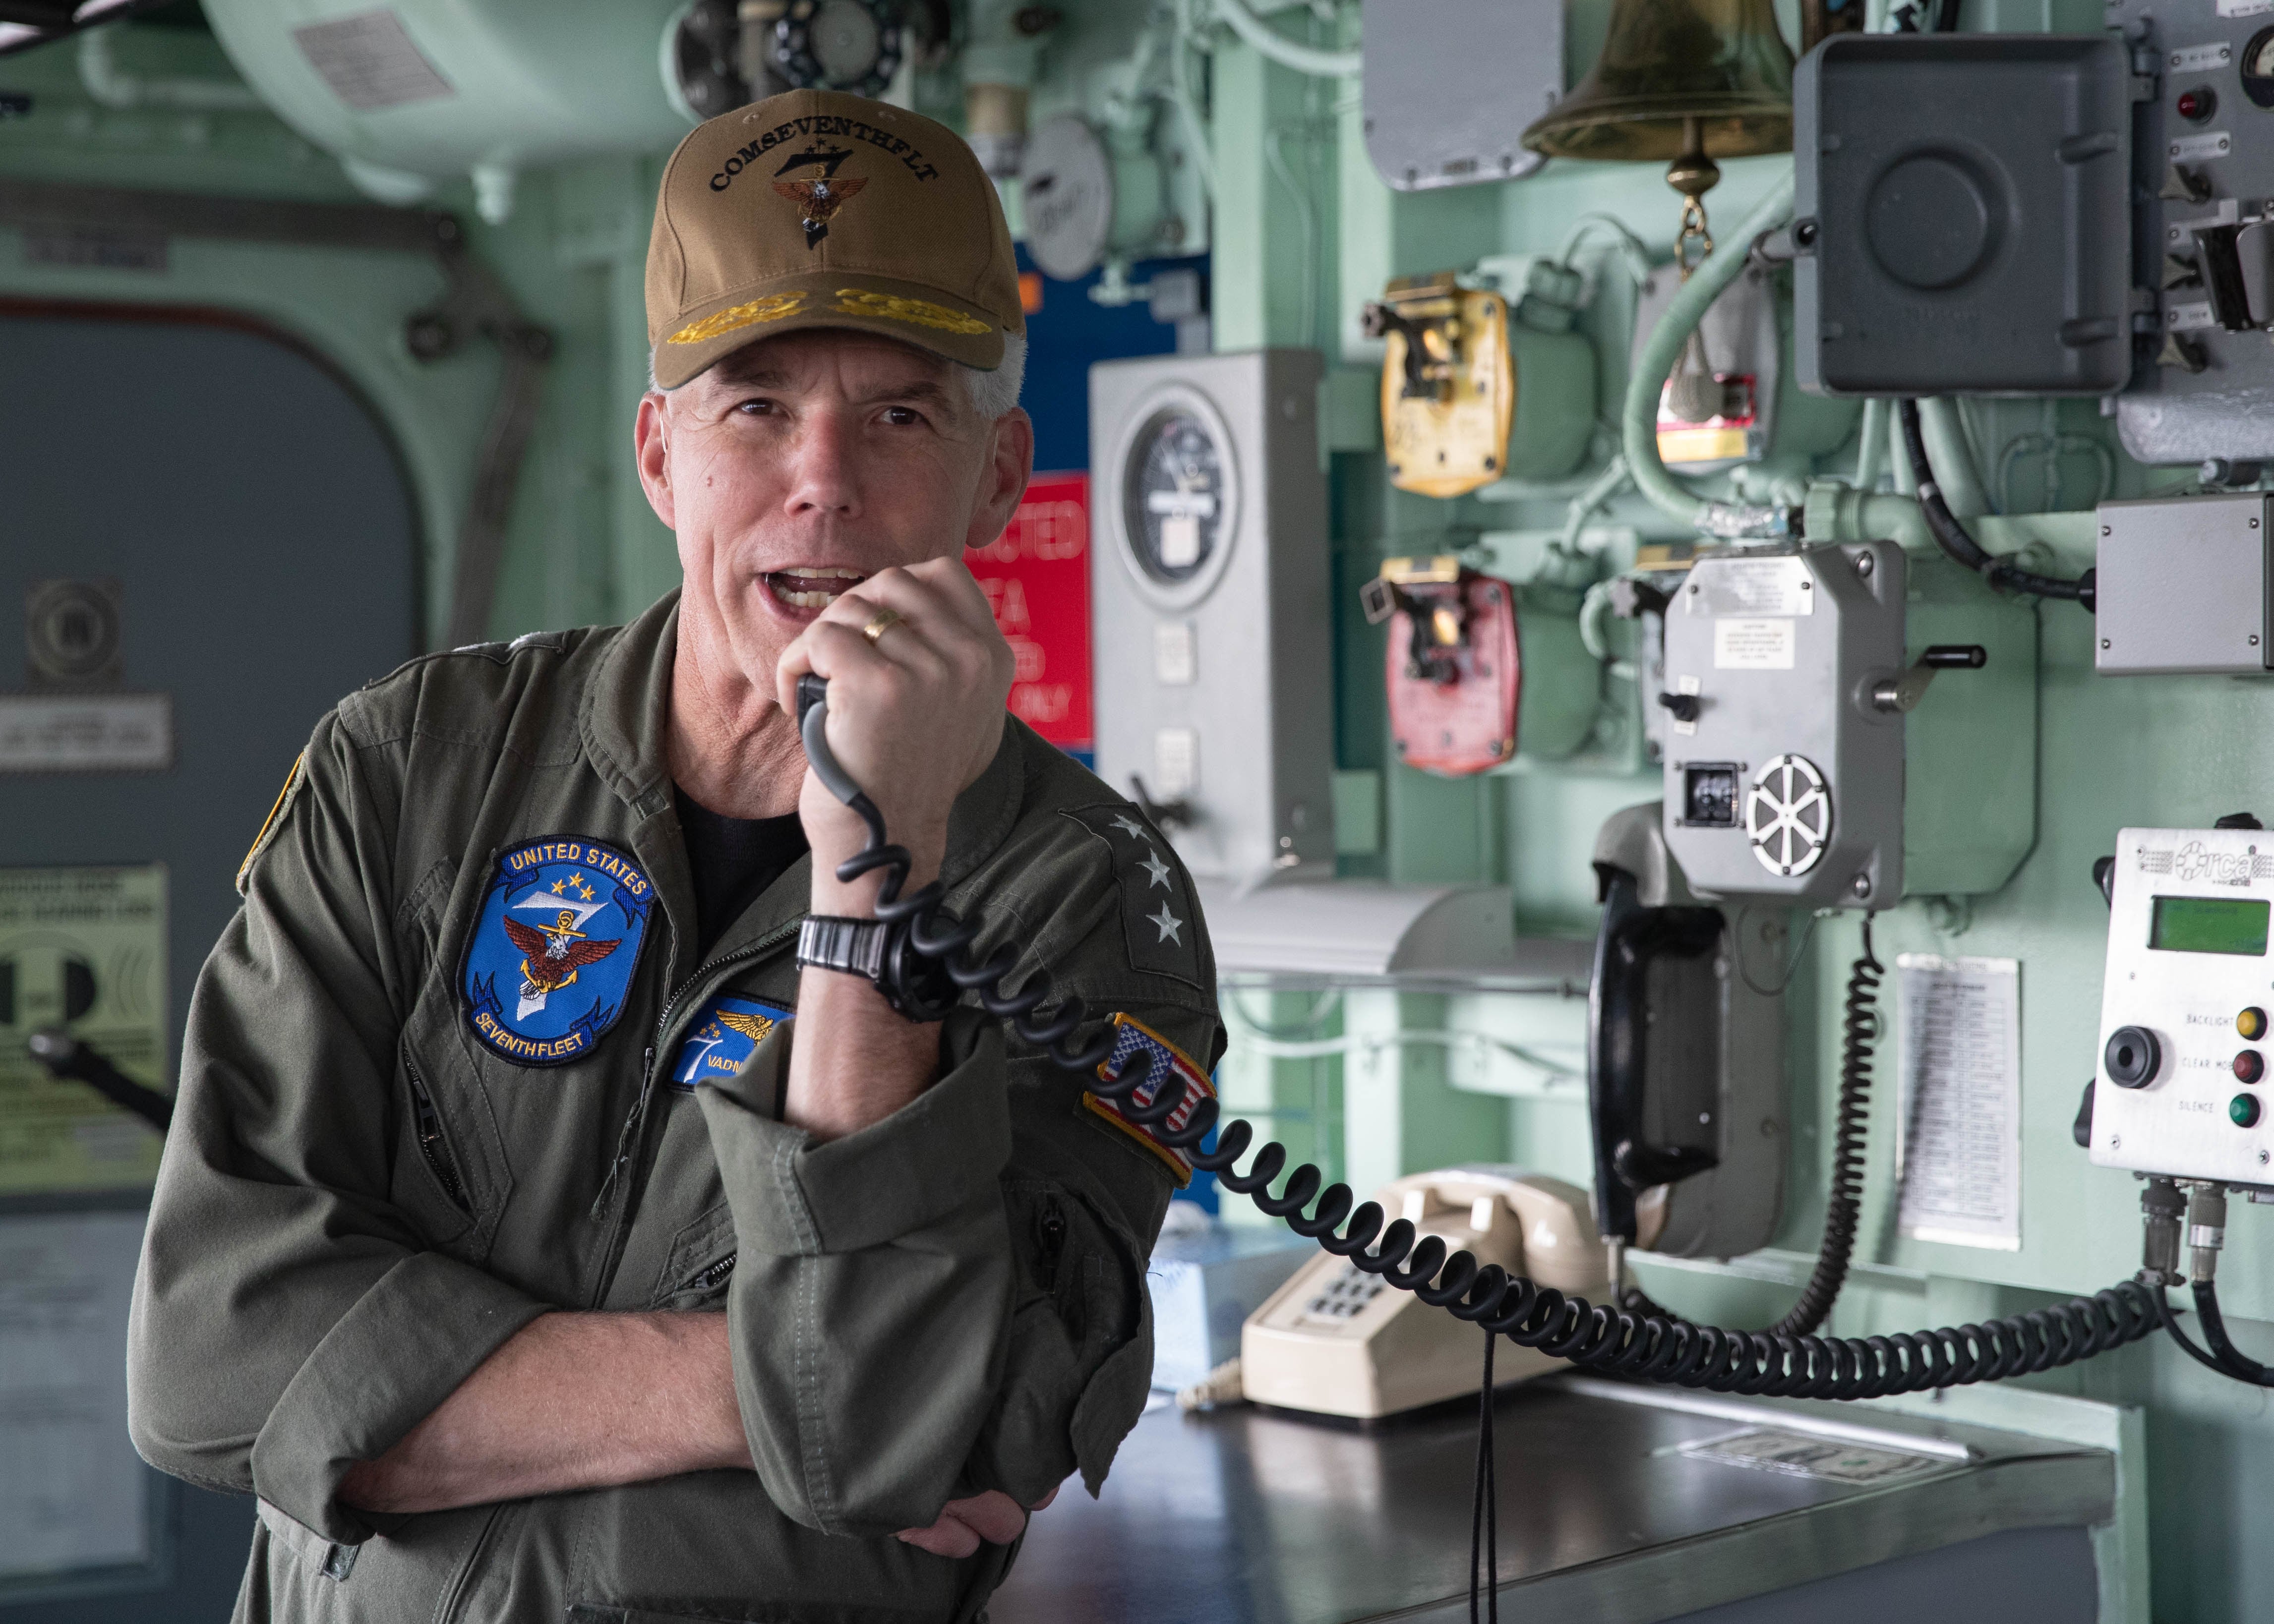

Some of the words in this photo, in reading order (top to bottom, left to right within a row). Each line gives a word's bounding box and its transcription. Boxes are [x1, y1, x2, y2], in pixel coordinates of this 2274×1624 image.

[710, 116, 939, 192] COMSEVENTHFLT
[510, 844, 581, 870] UNITED
[587, 848, 647, 895] STATES
[2185, 1014, 2234, 1027] BACKLIGHT
[2182, 1057, 2211, 1069] CLEAR
[2178, 1101, 2214, 1113] SILENCE
